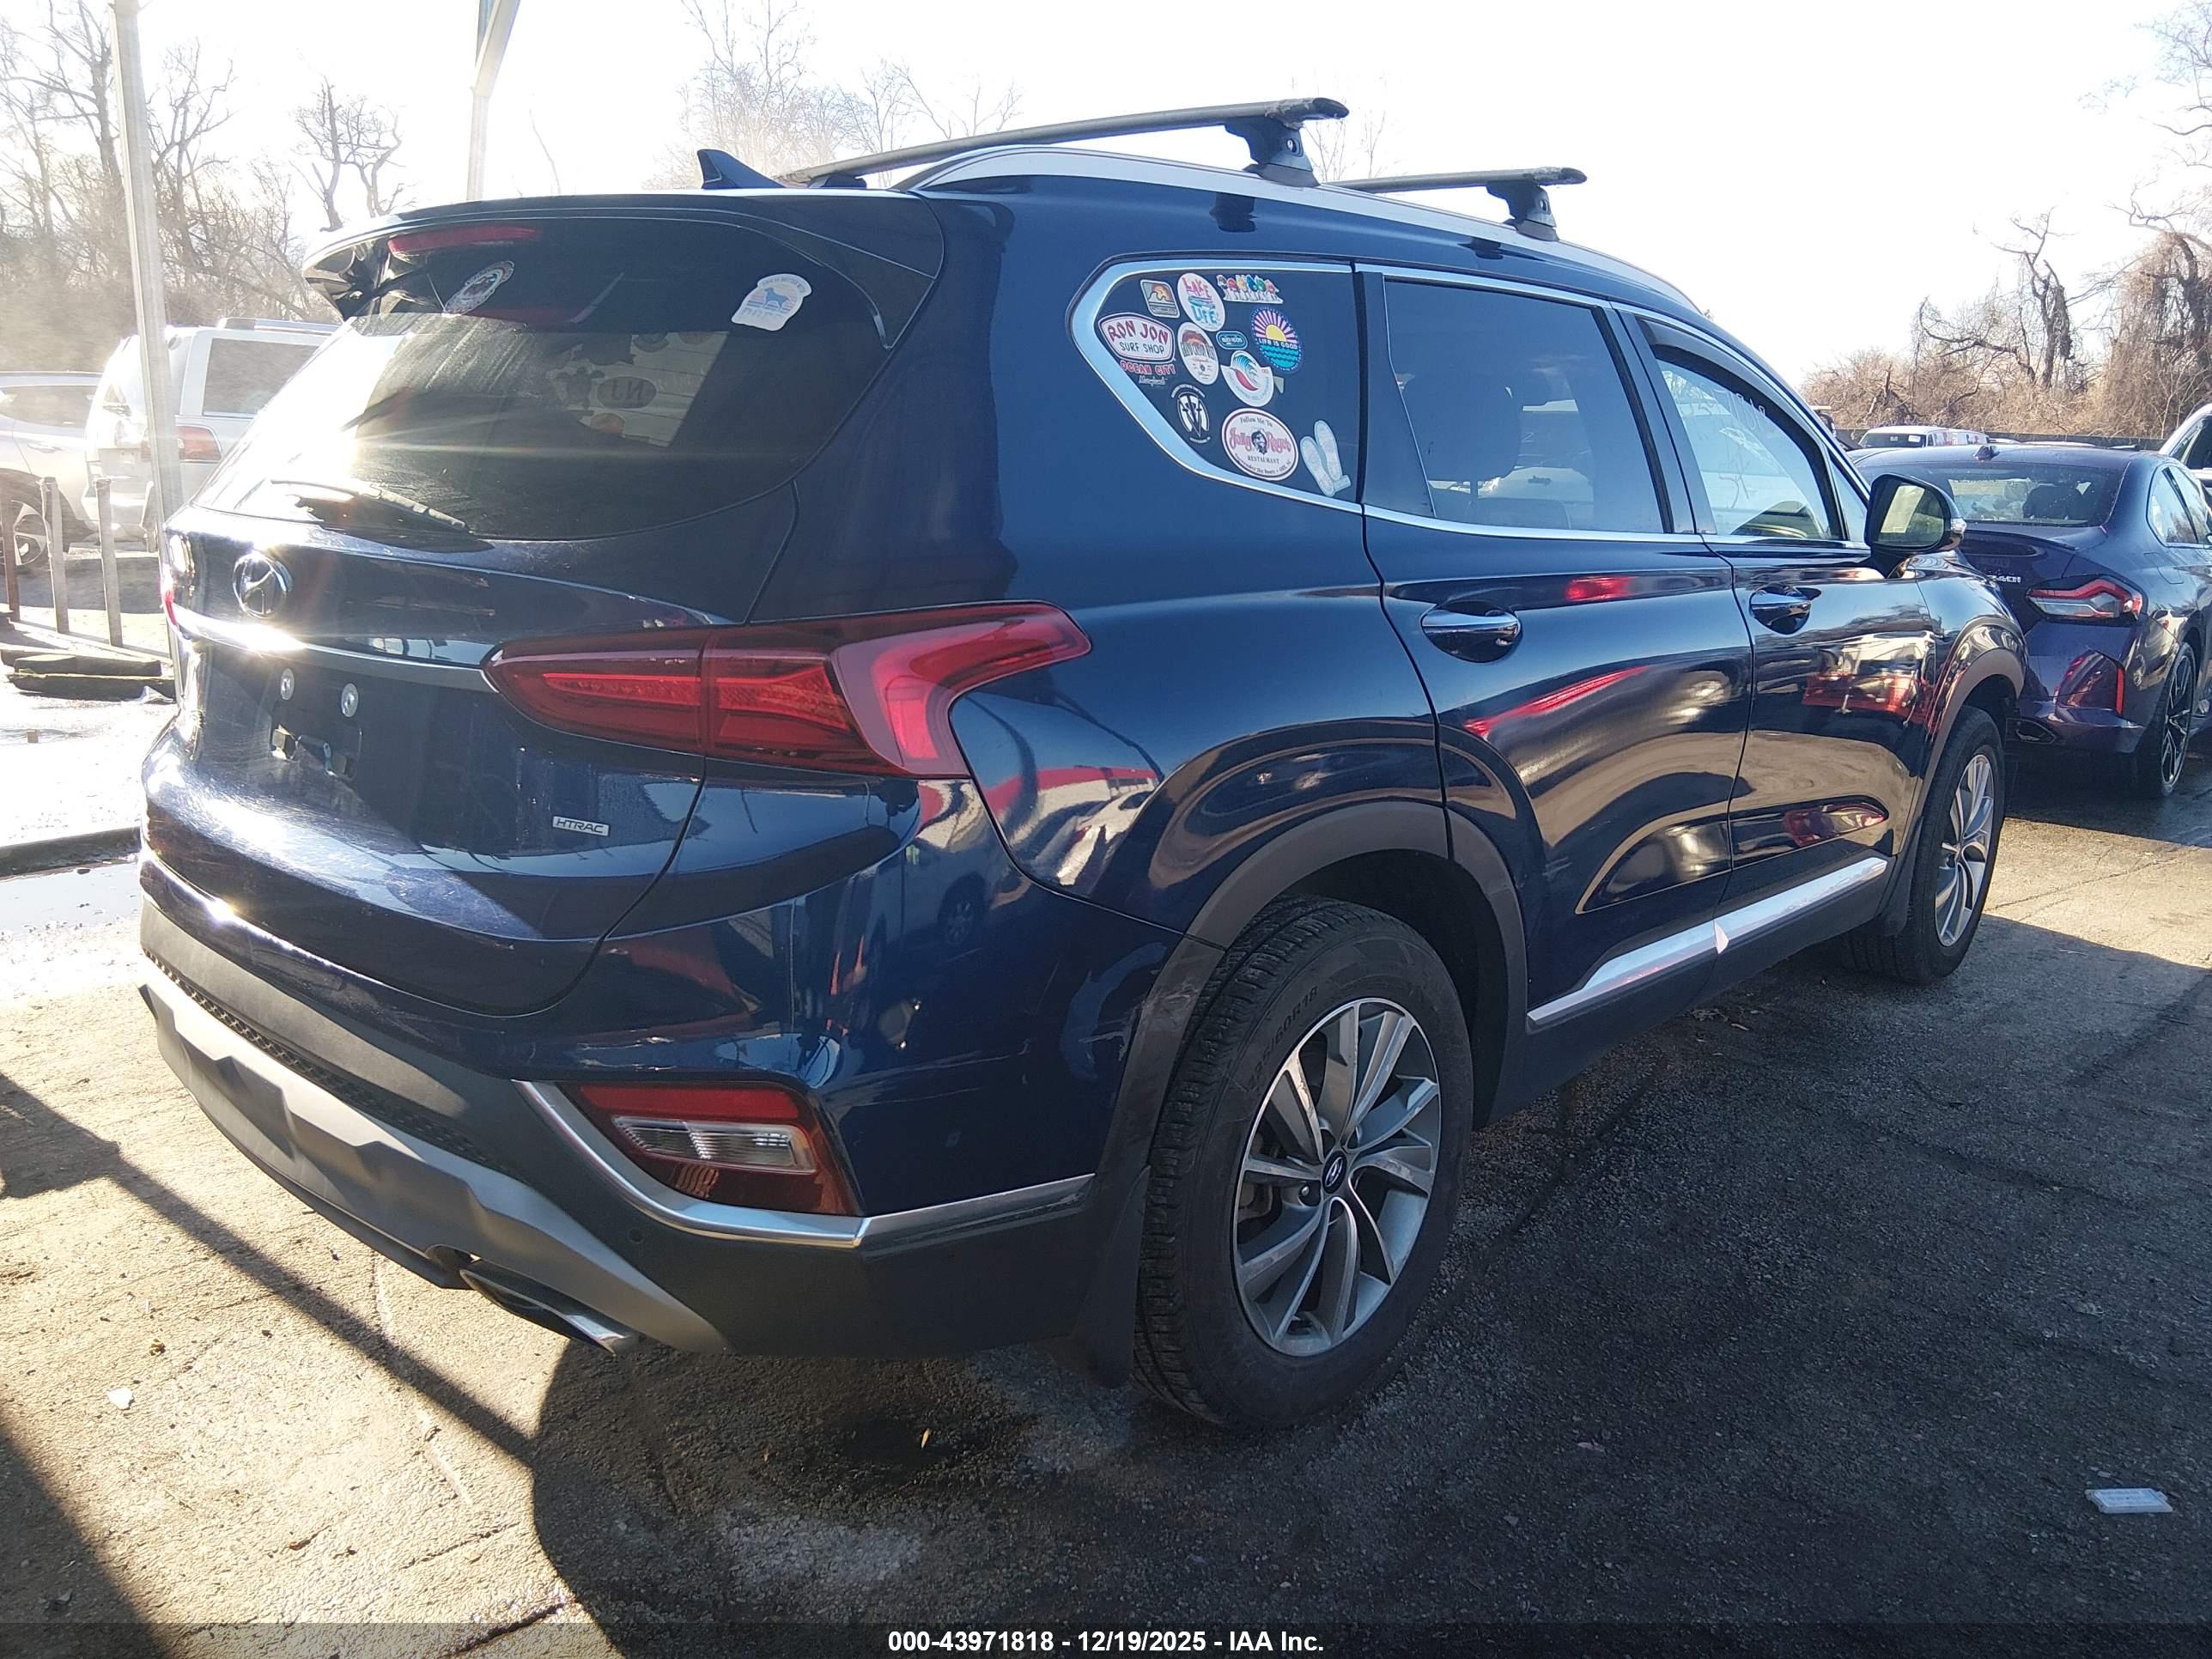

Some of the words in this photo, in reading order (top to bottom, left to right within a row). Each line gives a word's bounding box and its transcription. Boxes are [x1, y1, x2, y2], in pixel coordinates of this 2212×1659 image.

[1182, 276, 1212, 298] LAKE
[1107, 320, 1136, 342] RON
[1139, 322, 1169, 345] JON
[1119, 342, 1139, 352] SURF
[1142, 343, 1164, 355] SHOP
[1120, 360, 1152, 375] OCEAN
[1154, 363, 1176, 375] CITY
[1240, 416, 1256, 424] Follow
[1230, 428, 1252, 453] Jolly
[1266, 431, 1291, 453] Roger
[1247, 455, 1279, 465] RESTAURANT
[556, 818, 604, 834] HTRAC
